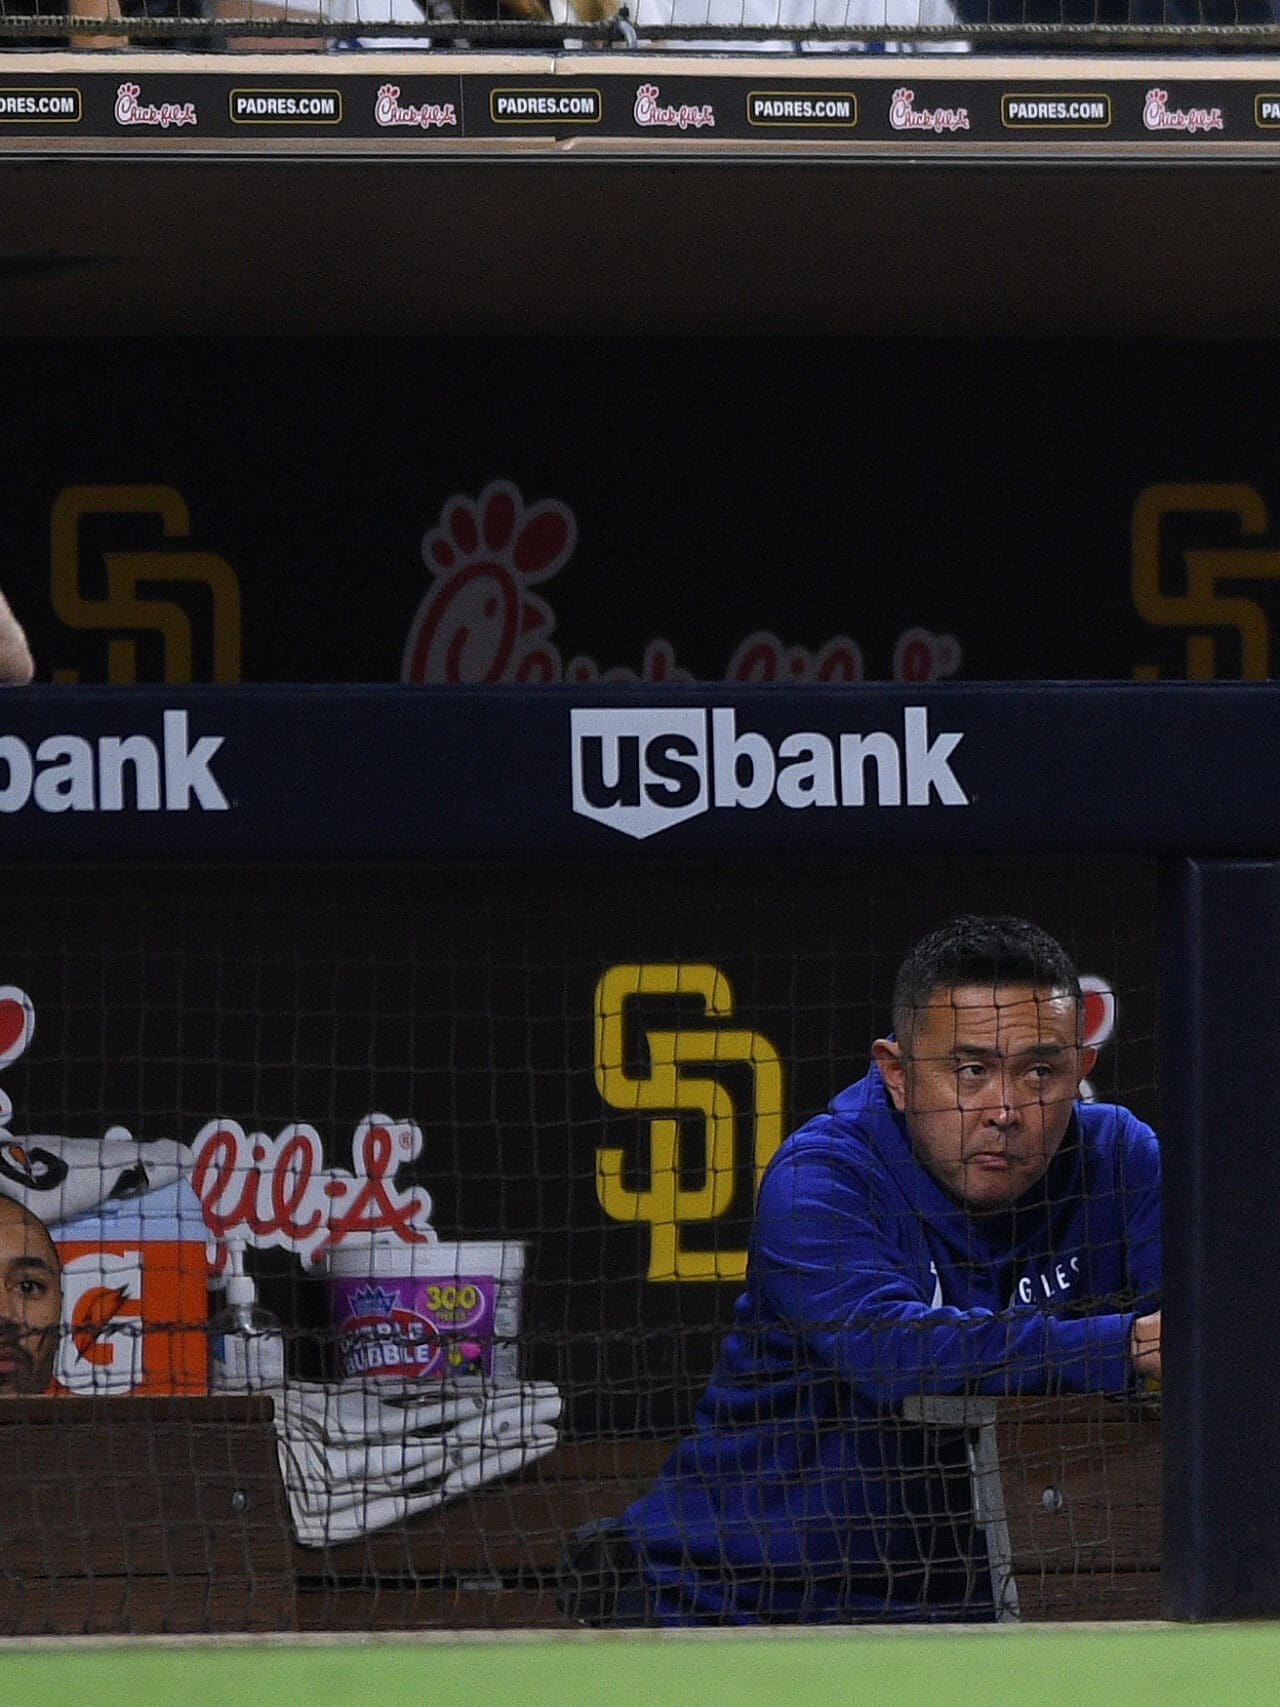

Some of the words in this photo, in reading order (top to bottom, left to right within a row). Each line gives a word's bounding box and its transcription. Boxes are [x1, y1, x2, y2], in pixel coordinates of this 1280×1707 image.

[0, 97, 74, 113] DRES.COM
[237, 98, 335, 115] PADRES.COM
[497, 97, 595, 114] PADRES.COM
[754, 100, 850, 118] PADRES.COM
[1008, 102, 1104, 119] PADRES.COM
[575, 730, 703, 809] us
[712, 706, 969, 810] bank
[594, 963, 784, 1282] SD
[426, 1284, 477, 1311] 300
